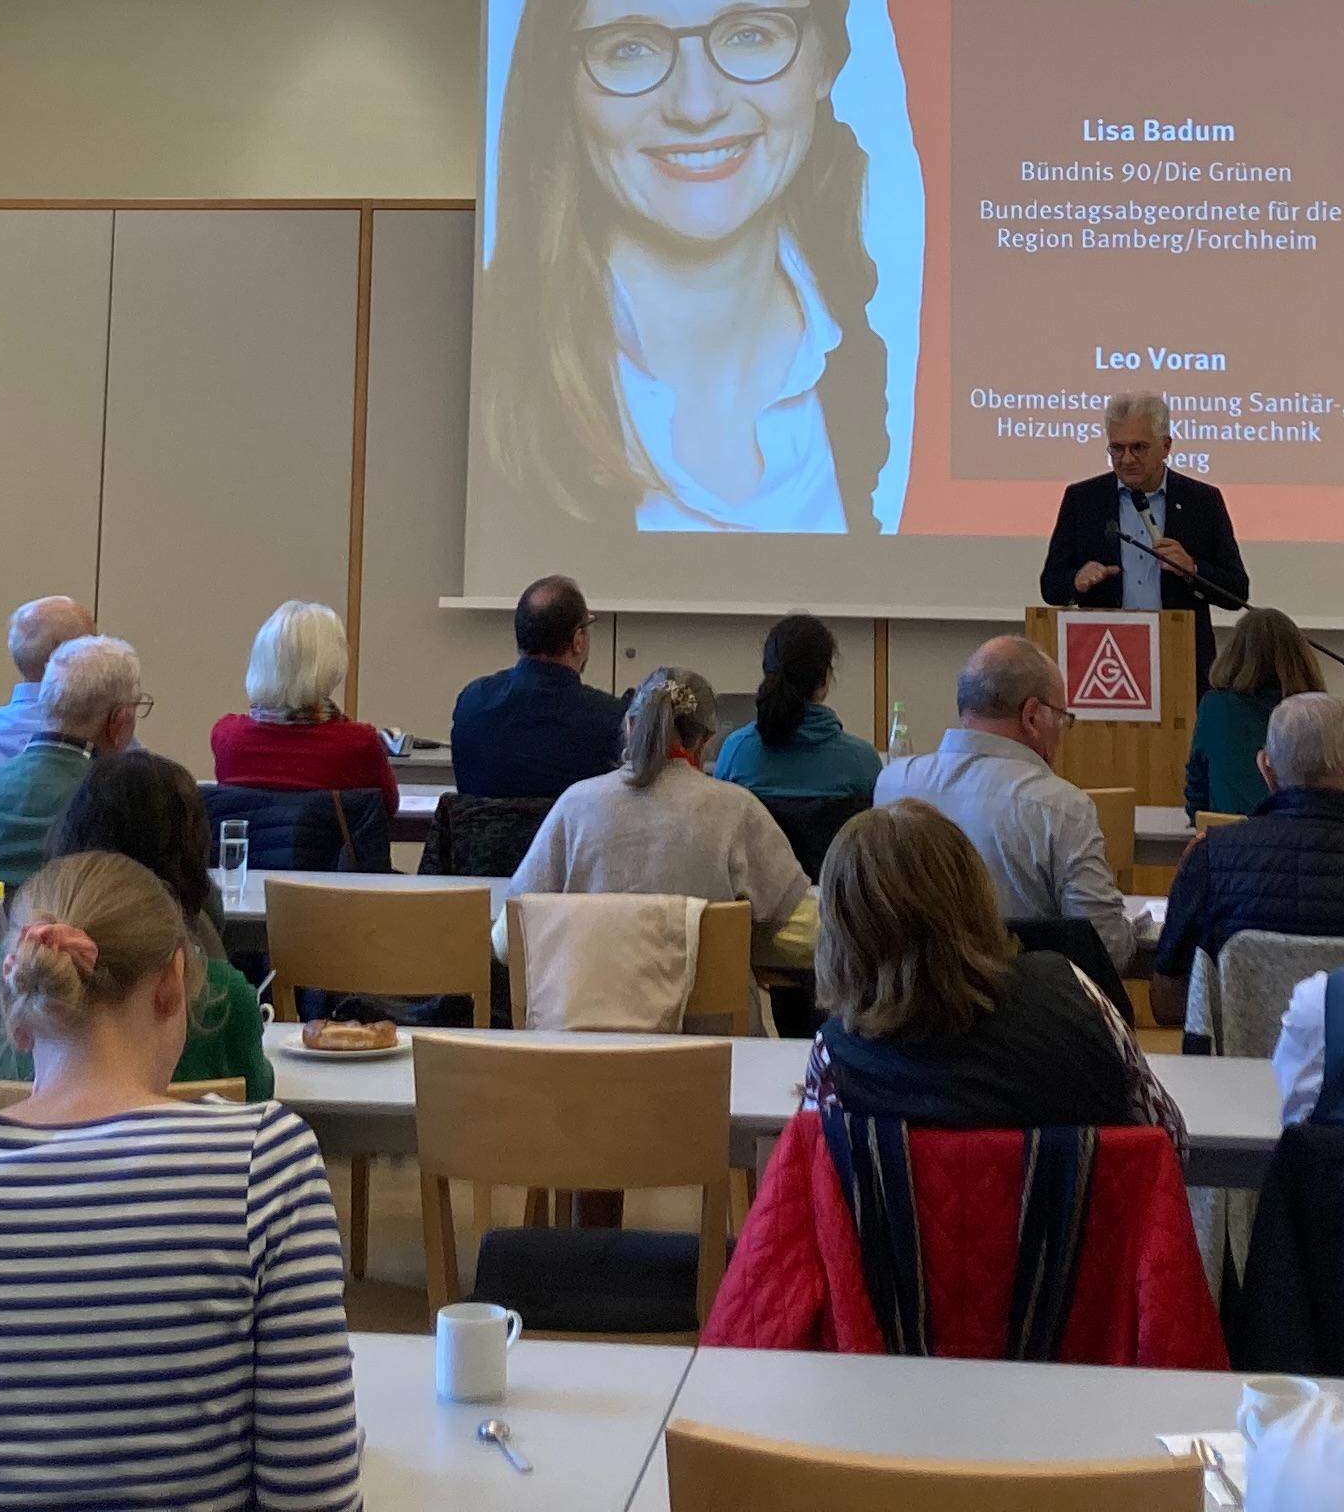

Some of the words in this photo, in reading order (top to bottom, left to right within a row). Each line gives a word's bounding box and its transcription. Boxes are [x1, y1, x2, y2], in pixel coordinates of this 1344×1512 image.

[1082, 118, 1135, 142] Lisa
[1143, 118, 1236, 142] Badum
[1020, 160, 1114, 182] Bündnis
[1121, 161, 1202, 185] 90/Die
[1208, 161, 1292, 183] Grünen
[979, 199, 1261, 225] Bundestagsabgeordnete
[1267, 200, 1299, 222] für
[1305, 200, 1343, 222] die
[997, 228, 1074, 253] Region
[1081, 228, 1318, 254] Bamberg/Forchheim
[1094, 346, 1141, 370] Leo
[1147, 347, 1227, 372] Voran
[969, 387, 1113, 410] Obermeister
[1169, 419, 1322, 443] Klimatechnik
